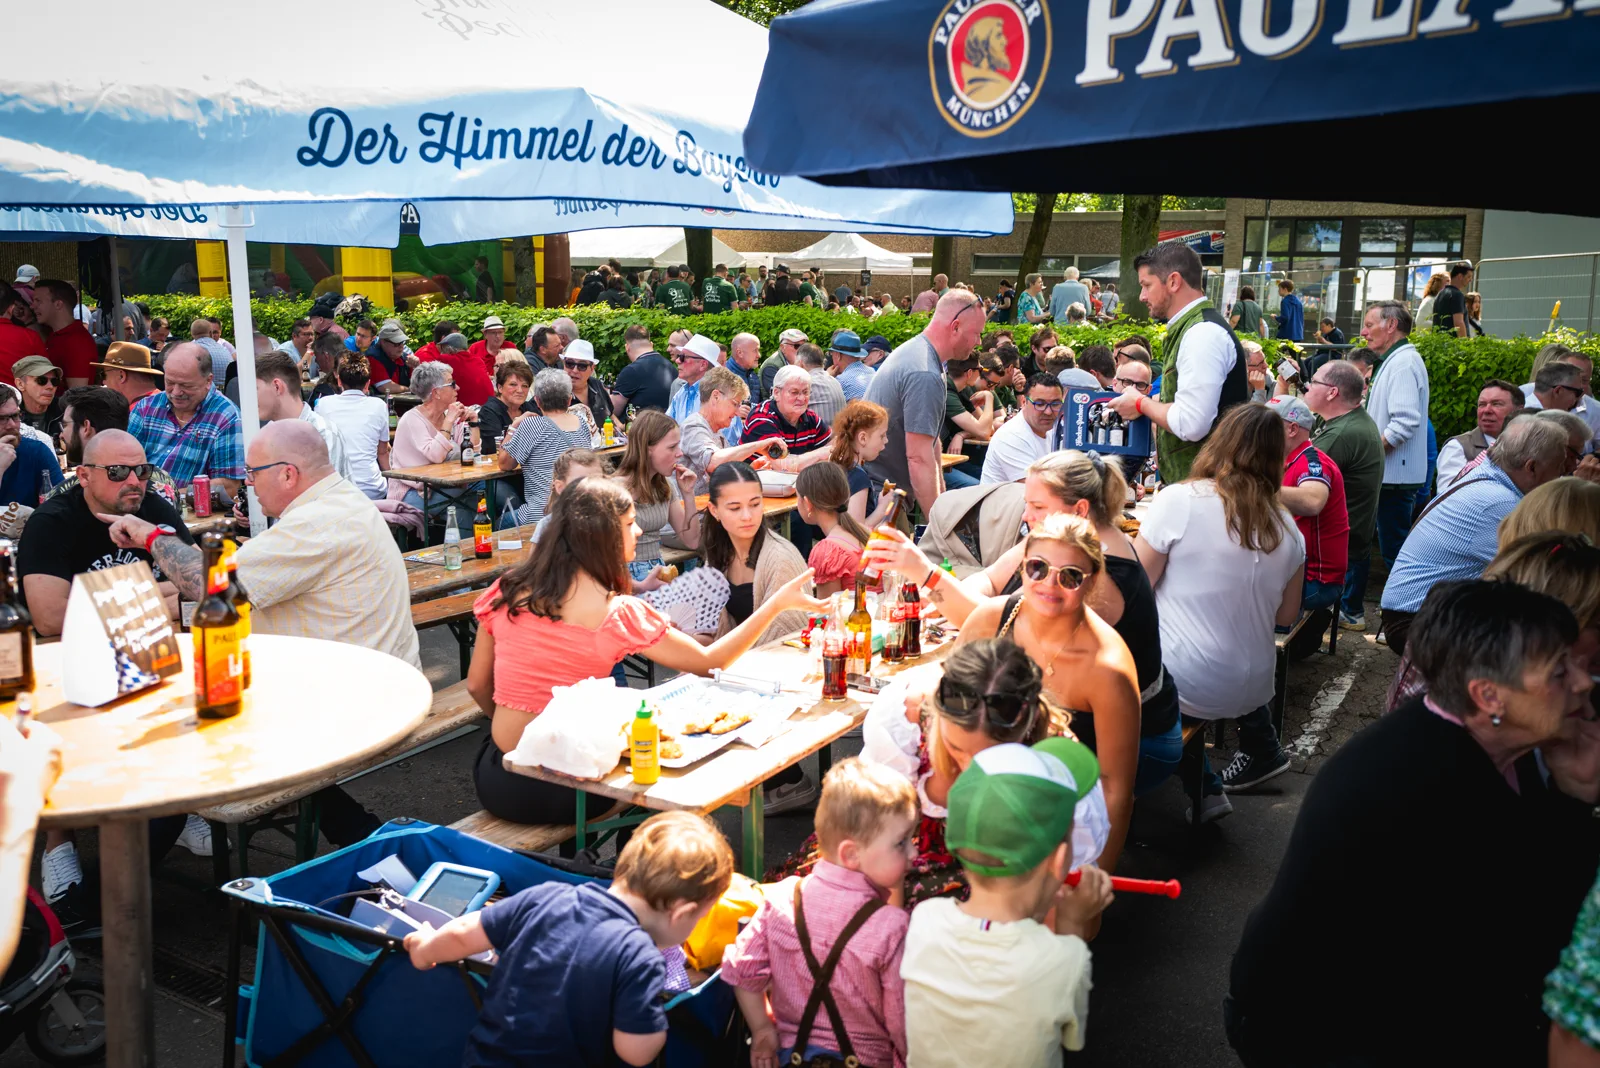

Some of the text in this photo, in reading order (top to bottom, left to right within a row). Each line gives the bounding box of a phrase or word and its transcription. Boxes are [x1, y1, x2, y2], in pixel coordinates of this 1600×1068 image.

[296, 107, 408, 168] Der
[418, 111, 597, 170] Himmel
[602, 124, 667, 169] der
